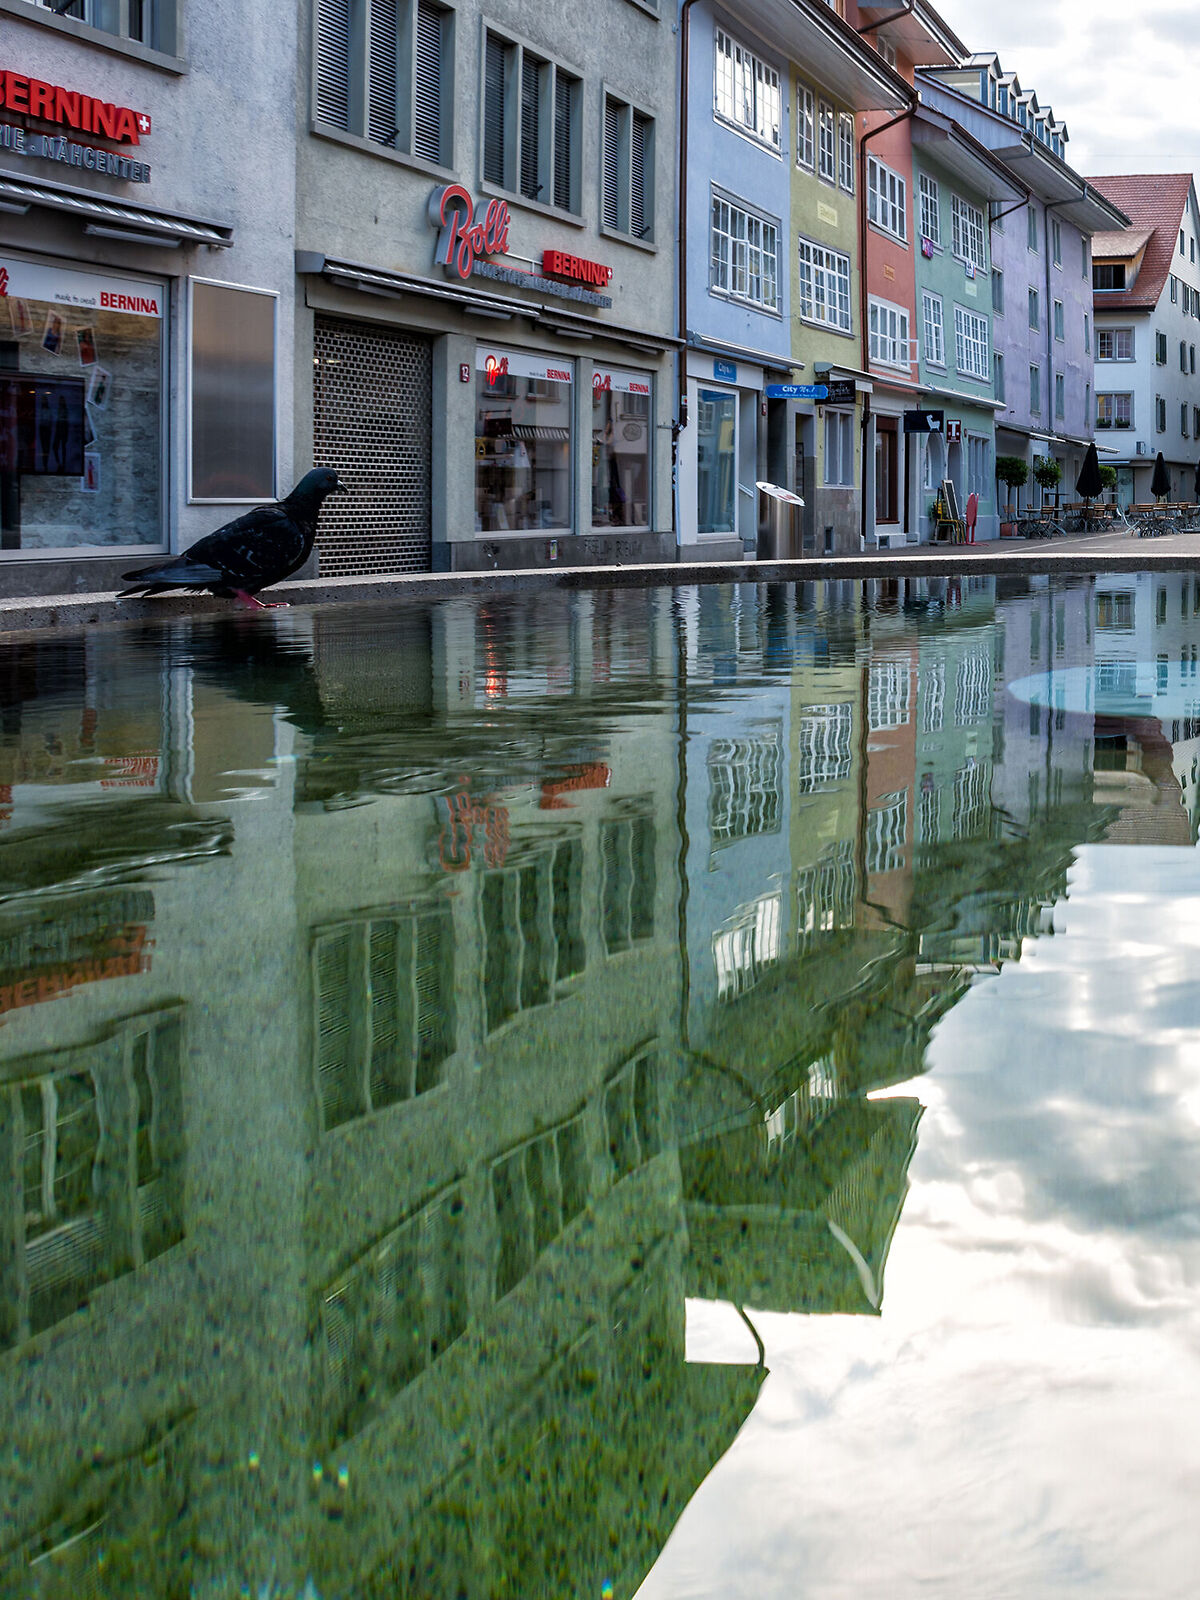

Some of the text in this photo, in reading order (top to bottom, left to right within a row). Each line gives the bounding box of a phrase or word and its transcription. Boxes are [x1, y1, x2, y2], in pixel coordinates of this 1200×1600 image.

[0, 70, 140, 146] ERNINA
[439, 184, 512, 280] Bolli
[552, 250, 609, 288] BERNINA
[100, 291, 159, 315] BERNINA
[546, 368, 571, 382] BERNINA
[628, 382, 650, 394] BERNINA
[782, 385, 798, 395] City
